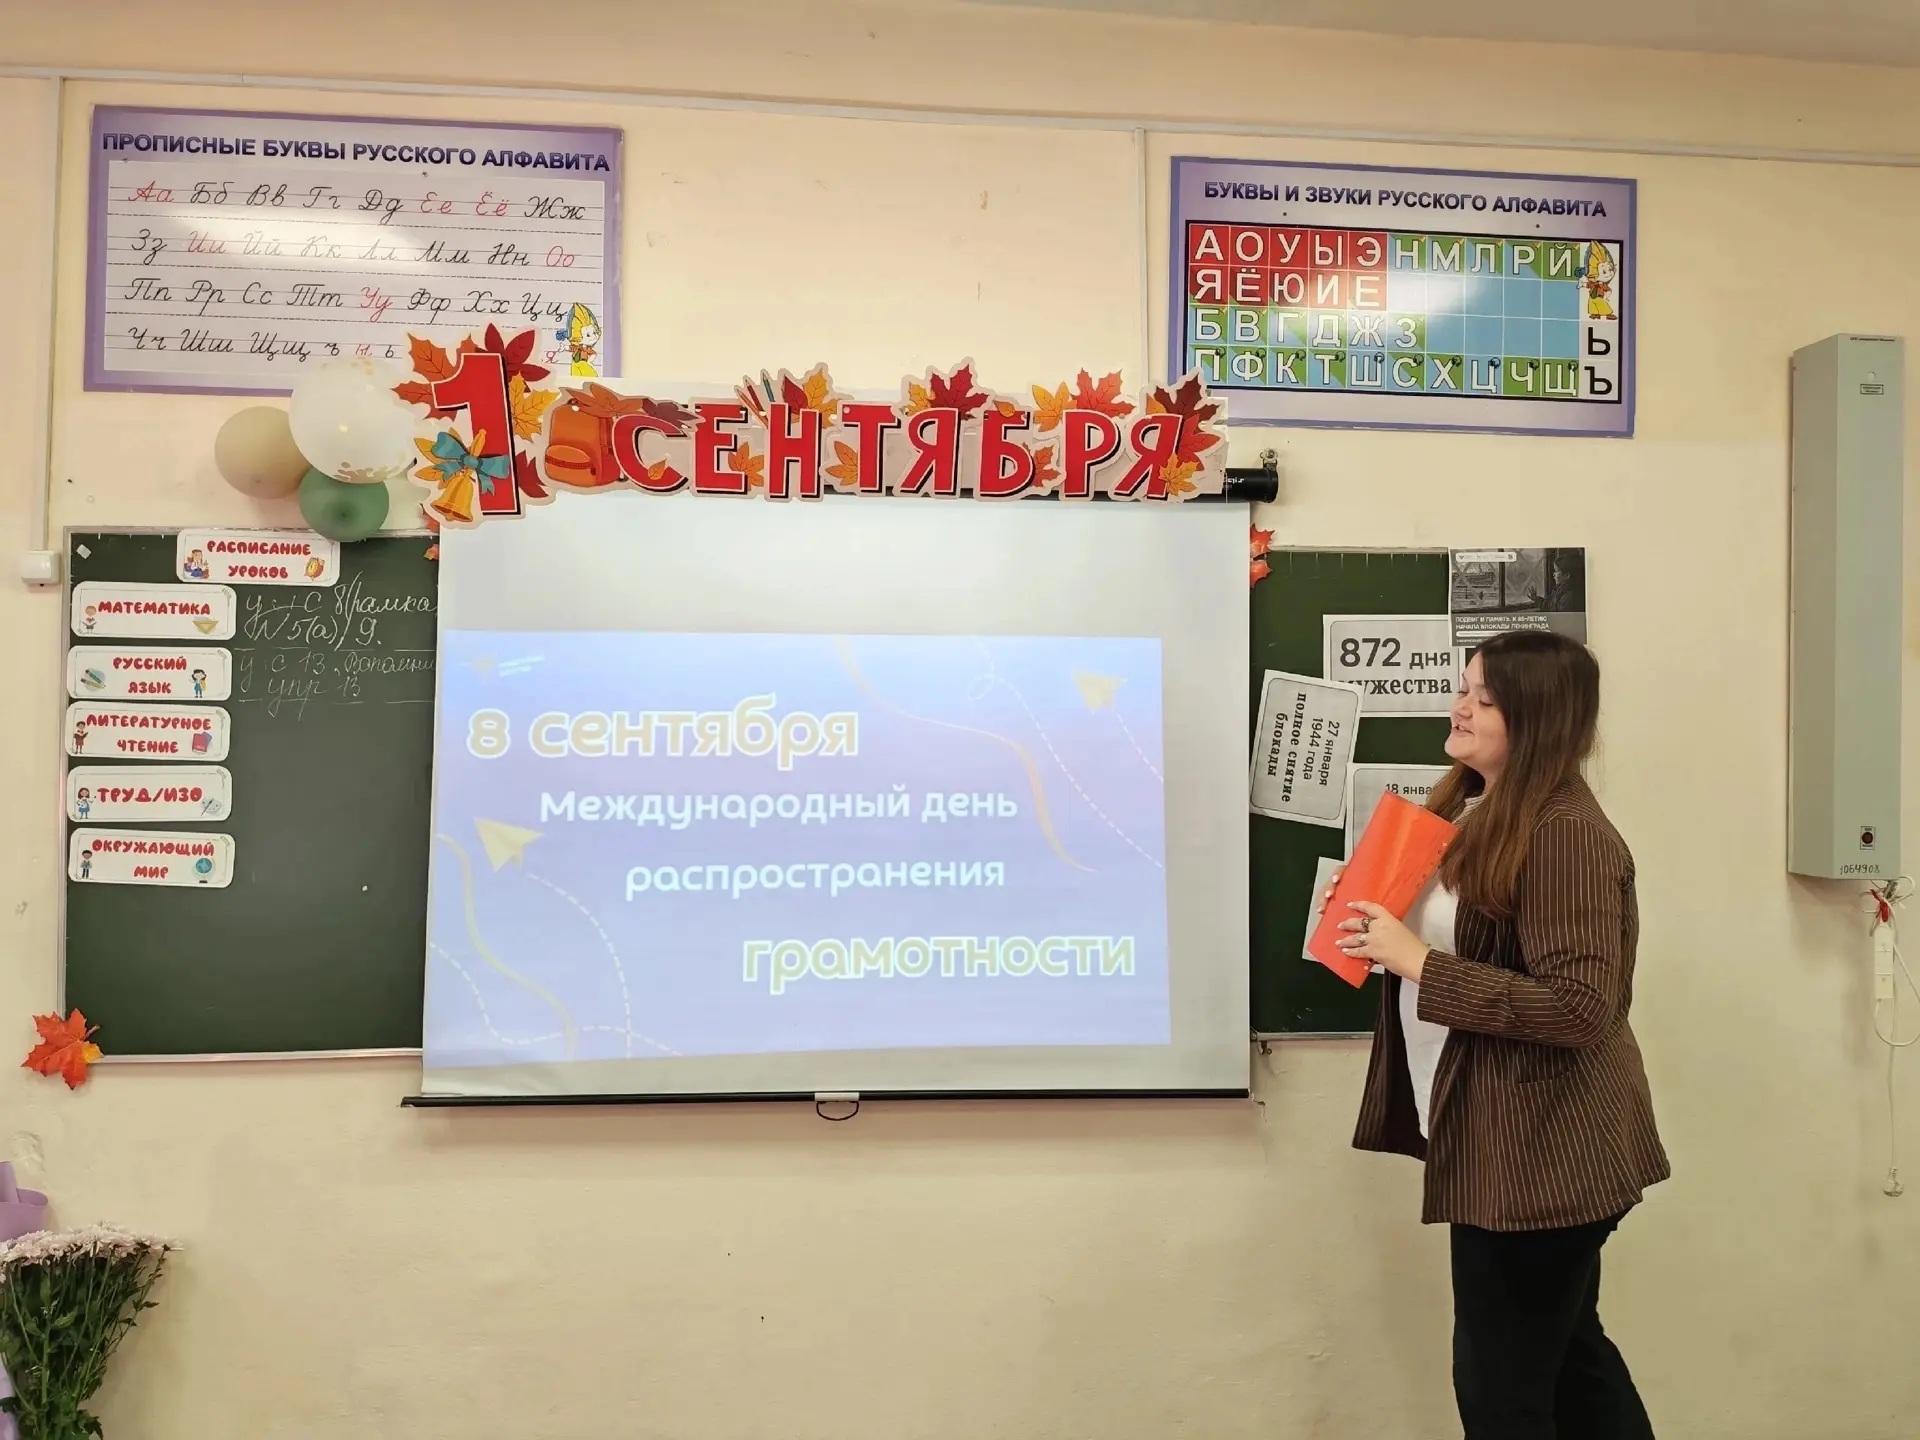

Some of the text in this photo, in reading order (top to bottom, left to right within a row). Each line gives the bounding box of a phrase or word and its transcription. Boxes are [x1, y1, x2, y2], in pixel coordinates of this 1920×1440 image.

[102, 133, 610, 171] ПРОПИСНЫЕ БУКВЫ РУССКОГО АЛФАВИТА
[1204, 181, 1607, 217] БУКВЫ И ЗВУКИ РУССКОГО АЛФАВИТА
[1194, 229, 1572, 277] А О У Ы Э Н М Л Р Й
[1194, 267, 1380, 307] Я Ё Ю И Е
[1195, 308, 1418, 348] Б В Г Д Ж З
[1231, 351, 1264, 381] Ф
[1276, 353, 1299, 383] К
[1315, 354, 1341, 385] Т
[1351, 355, 1382, 387] Ш
[1392, 357, 1418, 388] С
[1430, 358, 1458, 389] Х
[1471, 360, 1497, 394] Ц
[1510, 361, 1534, 393] Ч
[1544, 363, 1577, 396] Щ
[430, 352, 1184, 515] 1 СЕНТЯБРЯ
[207, 540, 312, 556] РАСПИСАНИЕ
[228, 565, 288, 579] УРОКОВ
[98, 601, 211, 615] МАТЕМАТИКА
[113, 656, 187, 670] РУССКИЙ
[1340, 638, 1451, 670] 872 дня
[128, 681, 172, 694] ЯЗЫК
[1339, 678, 1452, 694] ужества
[86, 714, 212, 731] ЛИТЕРАТУРНОЕ
[466, 692, 860, 771] 8 сентября
[117, 740, 179, 753] ЧТЕНИЕ
[1267, 712, 1288, 777] блокады
[1281, 692, 1307, 802] полное снятие
[1302, 718, 1324, 780] 1944 года
[1318, 720, 1340, 786] 27 января
[97, 787, 203, 803] ТРУД/ИЗО
[540, 784, 1018, 829] Международный день
[1403, 786, 1433, 796] янва
[92, 839, 215, 857] ОКРУЖАЮЩИЙ
[133, 866, 169, 879] МИР
[626, 861, 1005, 902] распространения
[743, 935, 1136, 995] грамотности
